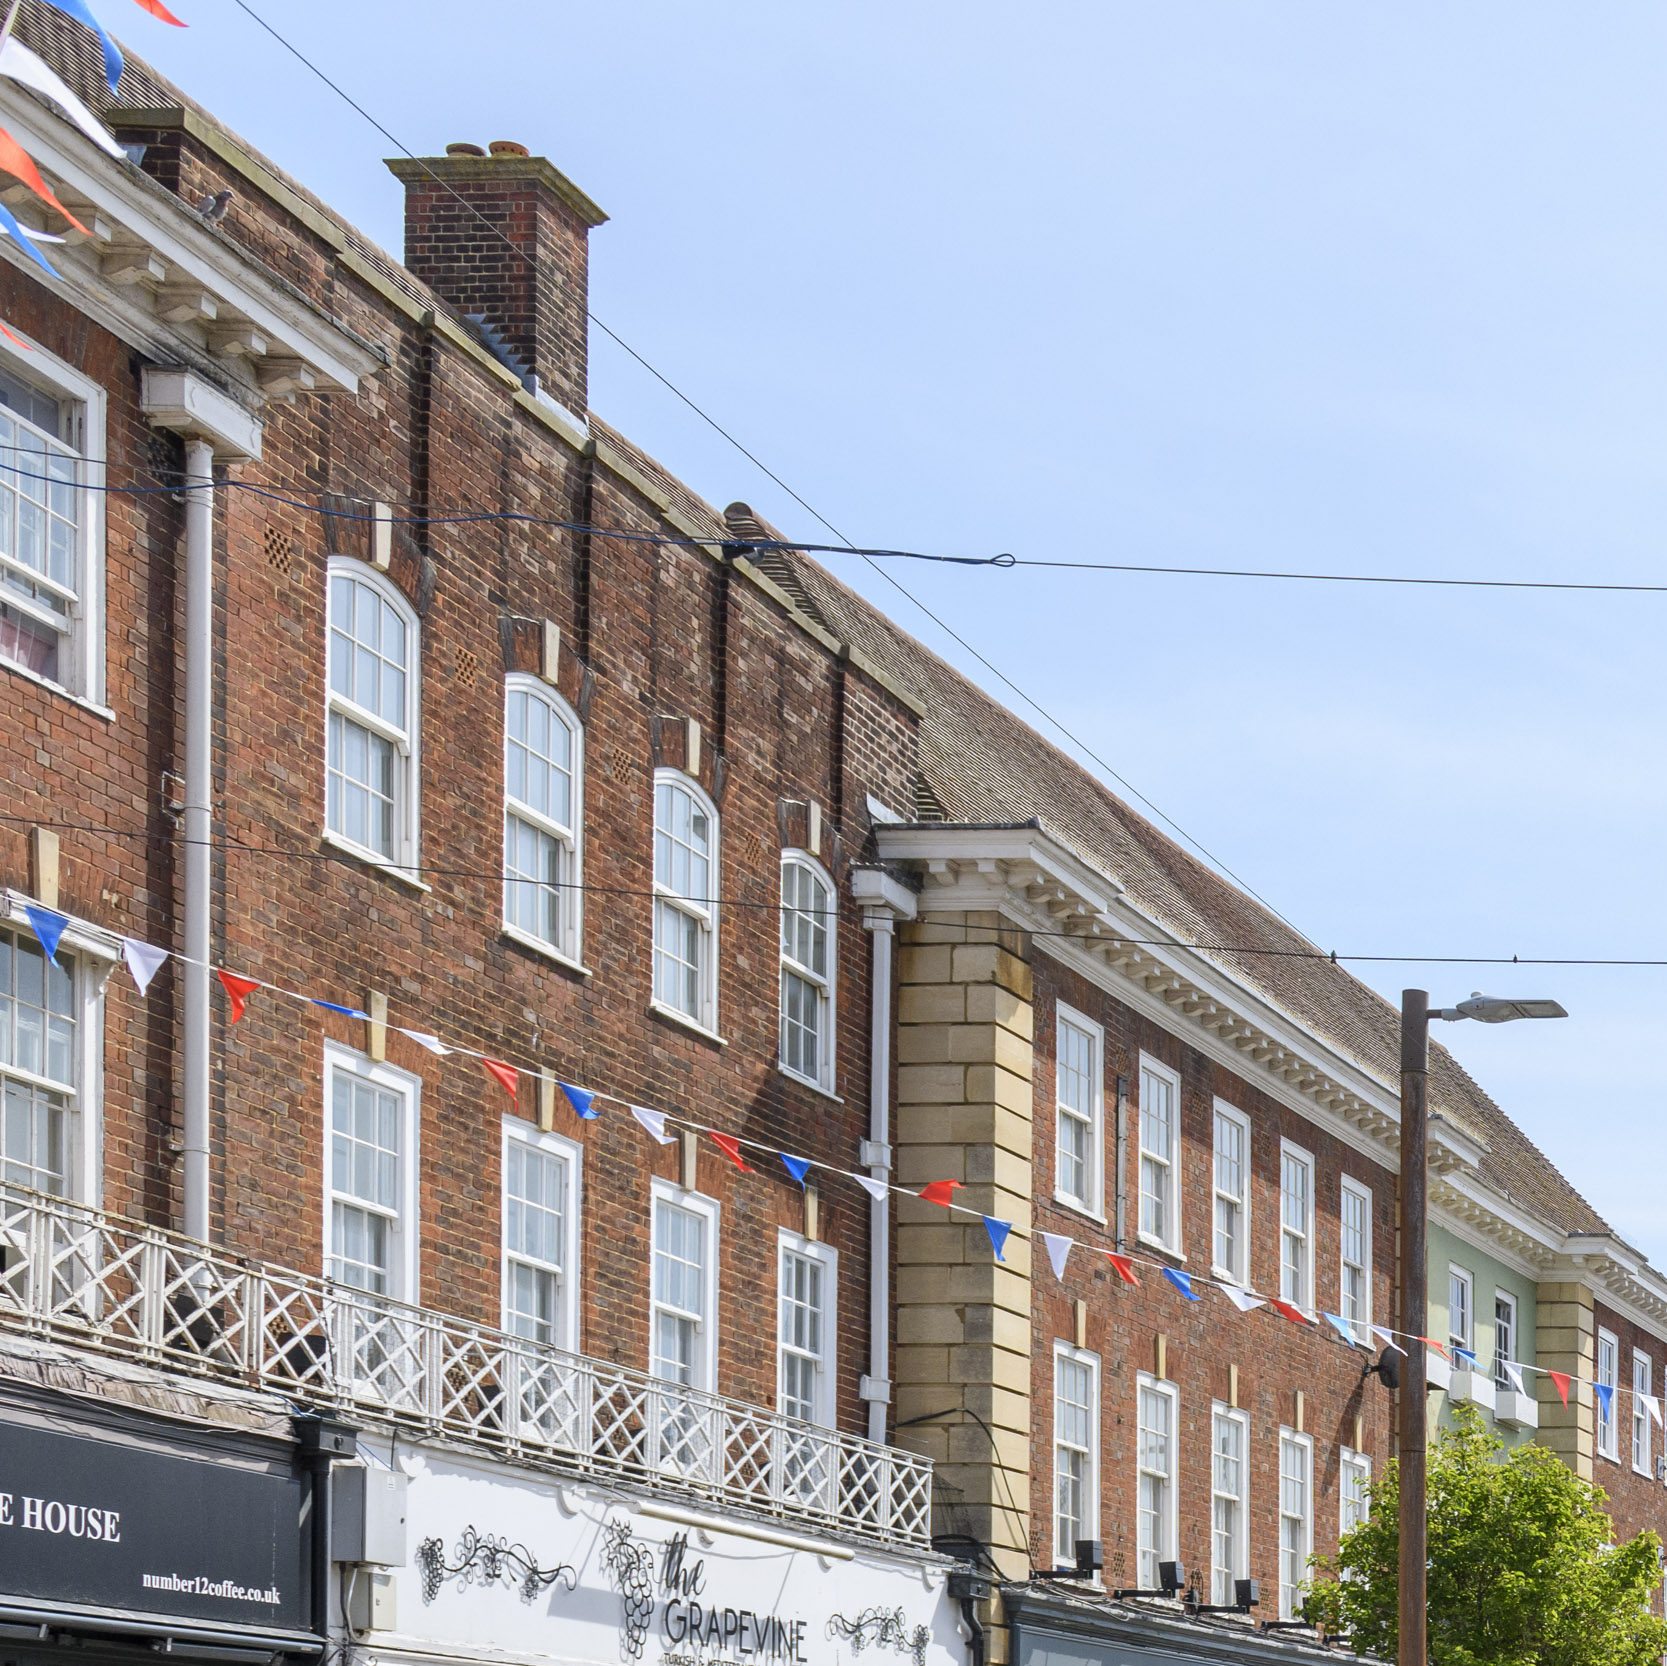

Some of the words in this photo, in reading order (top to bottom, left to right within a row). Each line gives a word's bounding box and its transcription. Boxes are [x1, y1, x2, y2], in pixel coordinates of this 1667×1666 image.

[21, 1496, 121, 1543] HOUSE
[142, 1573, 281, 1605] number12coffee.co.uk
[665, 1599, 808, 1663] GRAPEVINE
[664, 1652, 695, 1666] TURKISH
